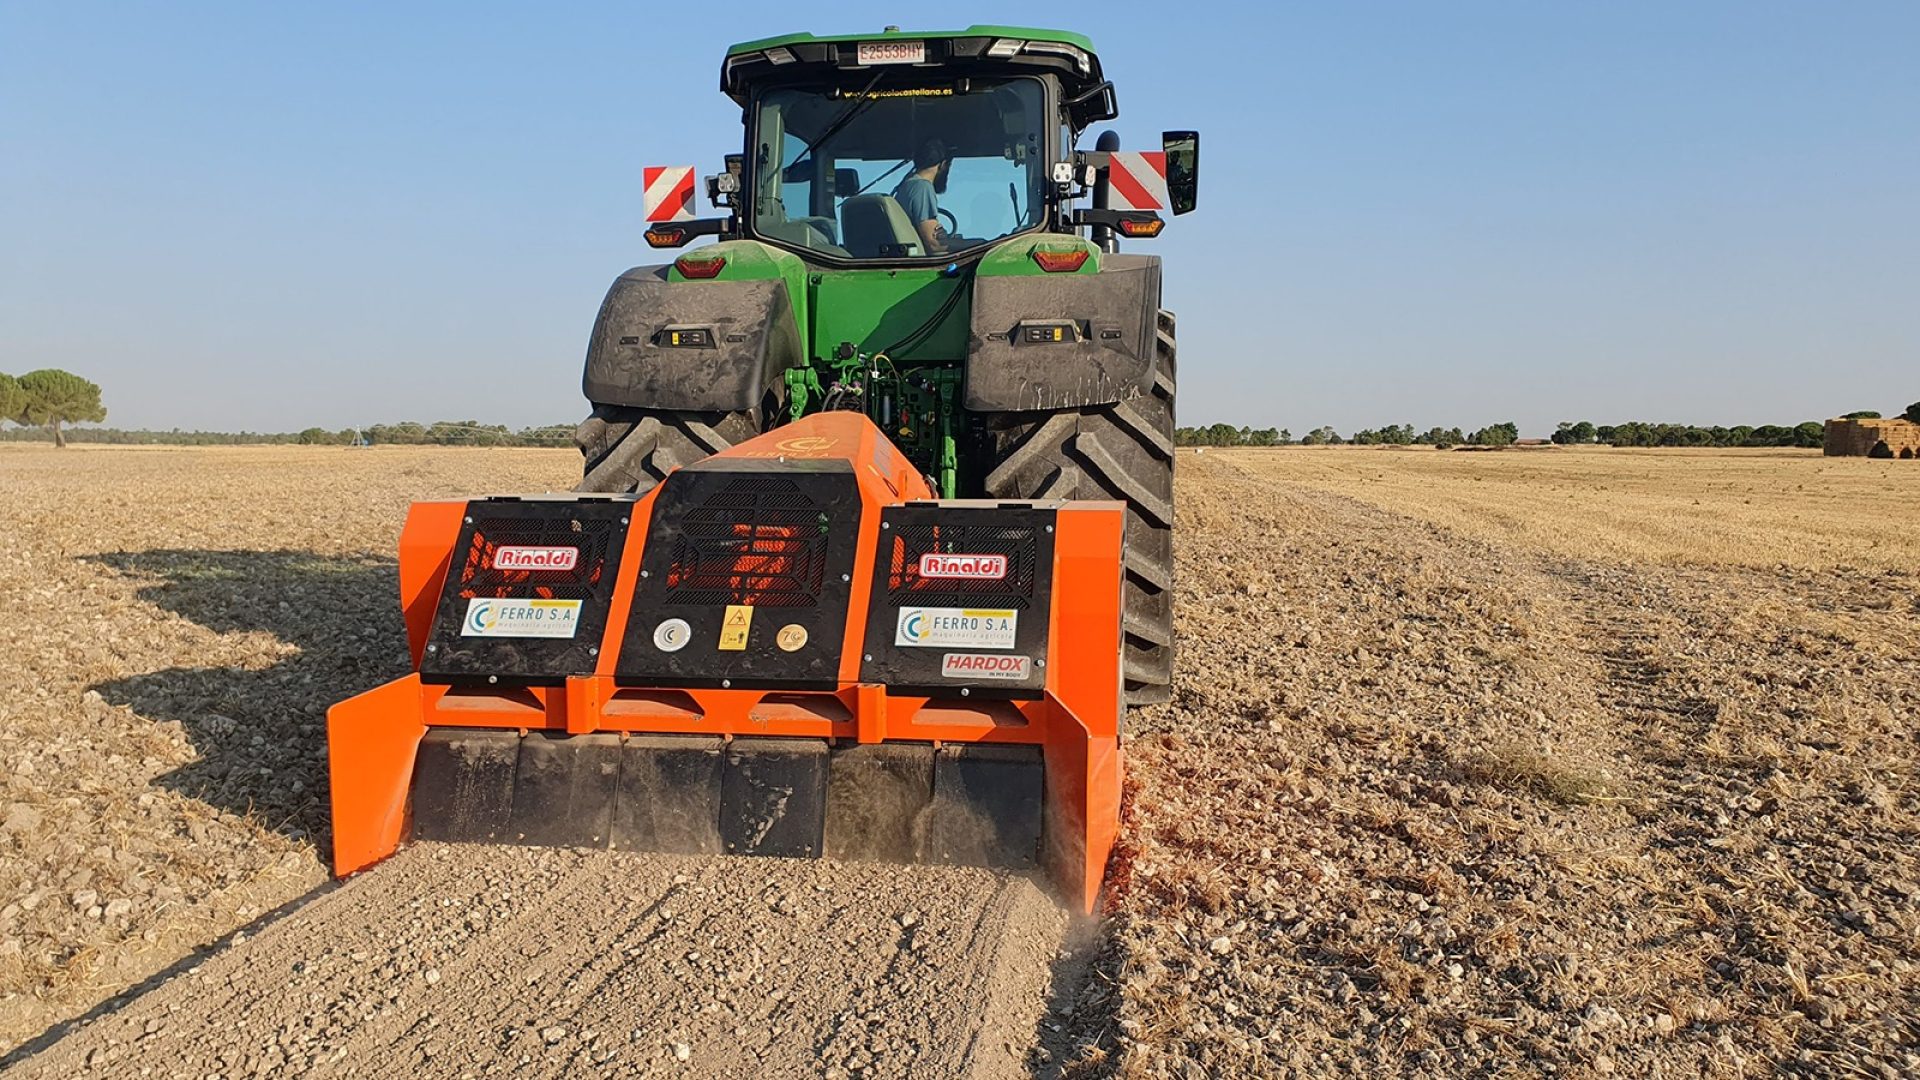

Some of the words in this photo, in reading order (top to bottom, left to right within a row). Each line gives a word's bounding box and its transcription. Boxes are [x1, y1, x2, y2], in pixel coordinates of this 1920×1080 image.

[500, 551, 572, 566] Rinaldi
[926, 558, 1000, 574] Rinaldi
[500, 607, 544, 620] FERRO
[549, 608, 576, 621] S.A.
[933, 616, 979, 631] FERRO
[985, 617, 1013, 632] S.A.
[946, 655, 1024, 672] HARDOX
